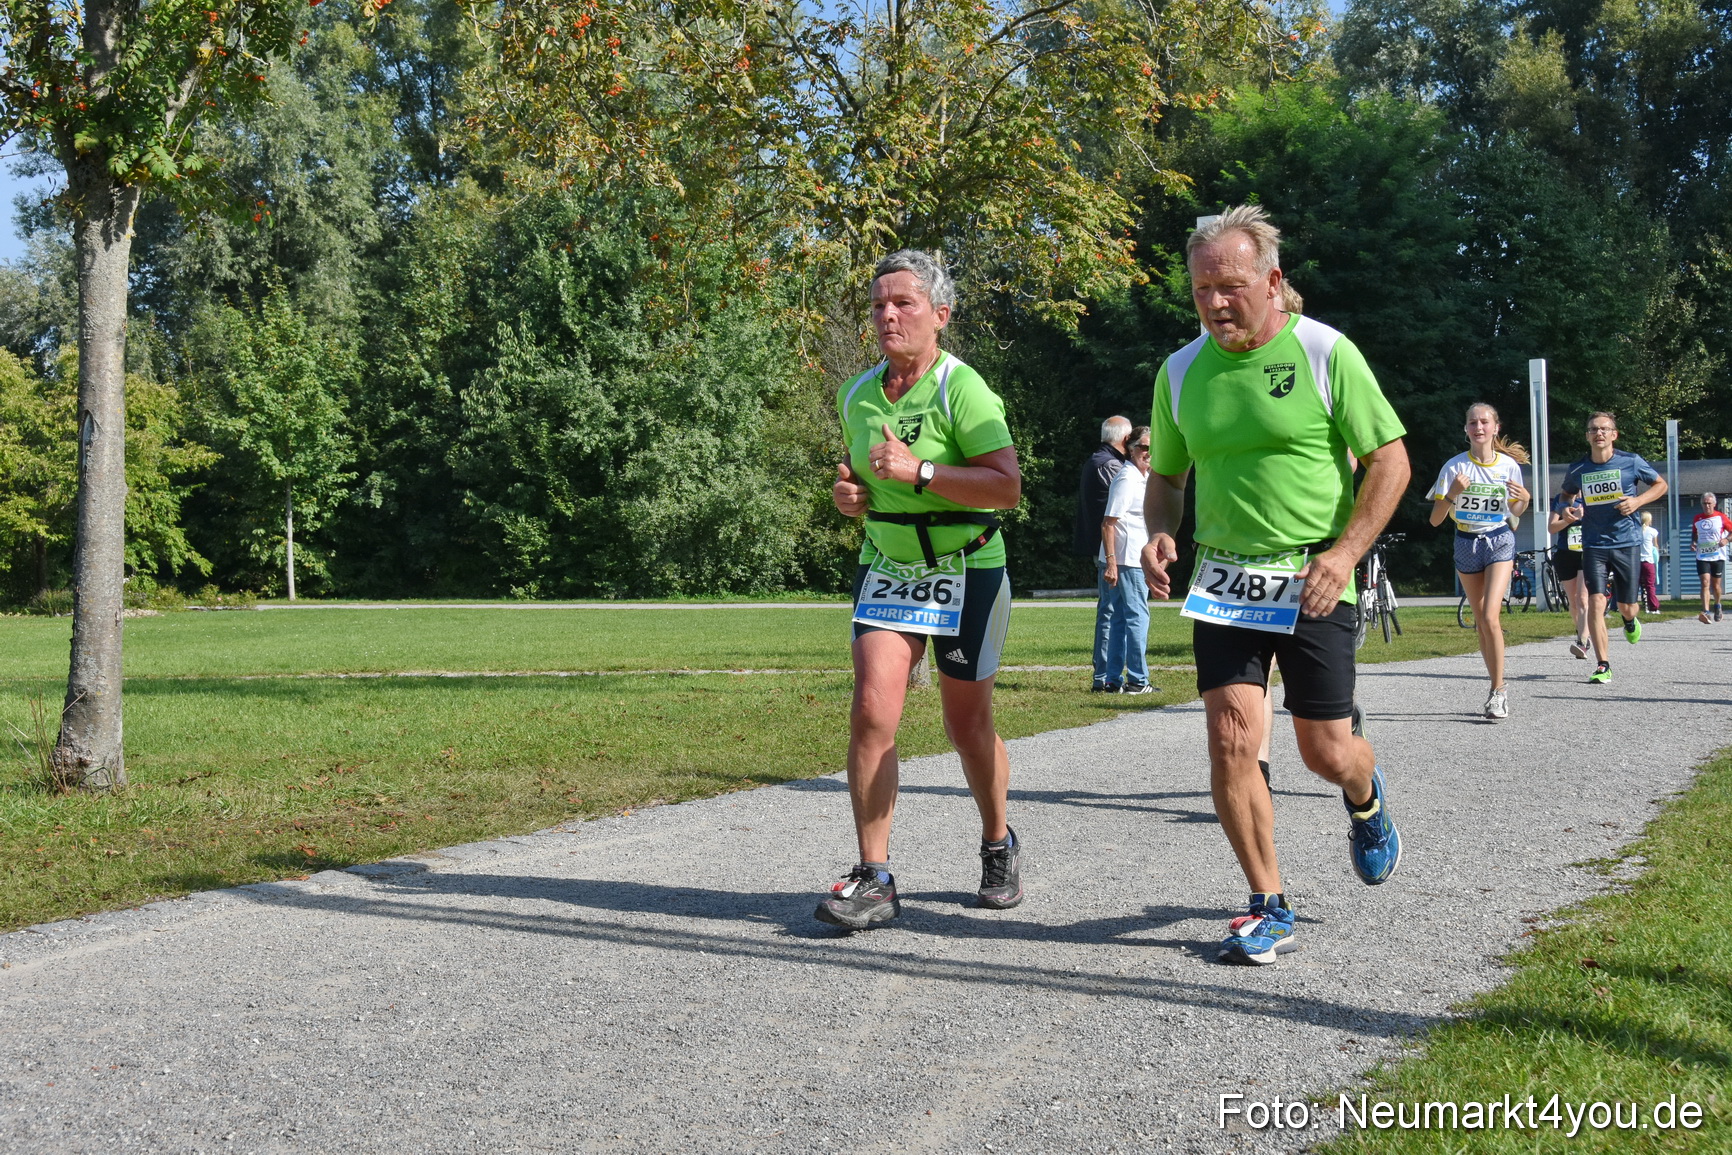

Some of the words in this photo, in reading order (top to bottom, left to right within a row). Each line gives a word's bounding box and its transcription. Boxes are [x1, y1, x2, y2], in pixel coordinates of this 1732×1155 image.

[1270, 374, 1278, 386] F
[1280, 381, 1289, 393] C
[900, 425, 908, 436] F
[907, 432, 916, 443] C
[1585, 471, 1617, 482] BOCK
[1587, 481, 1617, 495] 1080
[1461, 496, 1500, 512] 2519
[1592, 494, 1615, 502] ULRICH
[1466, 513, 1492, 522] CARLA
[1205, 567, 1290, 603] 2487
[871, 578, 953, 605] 2486
[866, 607, 951, 625] CHRISTINE
[1206, 603, 1276, 622] HUBERT
[945, 653, 968, 665] adidas
